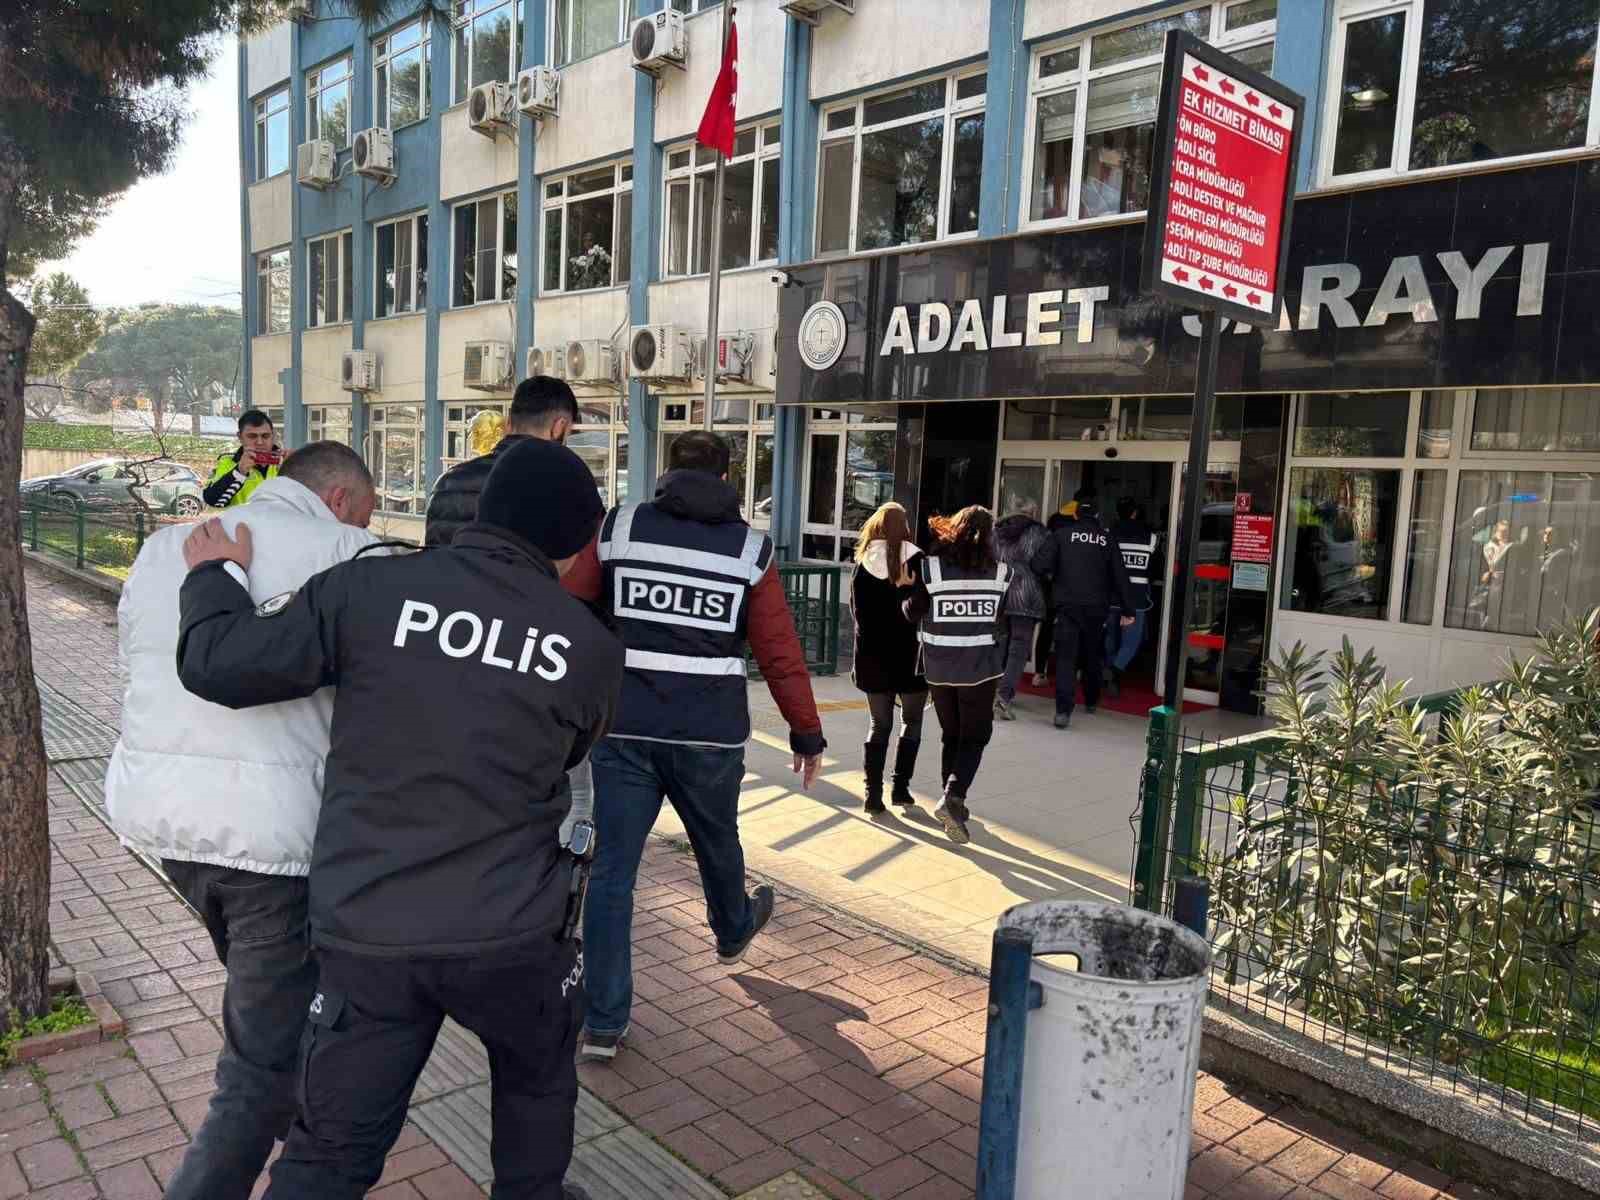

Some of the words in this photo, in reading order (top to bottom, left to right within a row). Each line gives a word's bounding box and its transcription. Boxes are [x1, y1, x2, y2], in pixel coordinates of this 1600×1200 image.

[1179, 114, 1192, 135] ÖN
[1193, 122, 1216, 145] BÜRO
[1184, 87, 1200, 111] EK
[1203, 97, 1247, 131] HİZMET
[1249, 118, 1285, 150] BİNASI
[1177, 138, 1197, 158] ADLİ
[1198, 145, 1217, 167] SİCİL
[1175, 155, 1194, 178] İCRA
[1196, 165, 1245, 198] MÜDÜRLÜĞÜ
[1171, 199, 1220, 230] HİZMETLERİ
[1220, 217, 1265, 247] MÜDÜRLÜĞÜ
[1173, 180, 1193, 199] ADLİ
[1194, 187, 1225, 210] DESTEK
[1225, 200, 1236, 215] VE
[1236, 206, 1266, 228] MAĞDUR
[1169, 221, 1194, 241] SEÇİM
[1195, 230, 1243, 258] MÜDÜRLÜĞÜ
[1167, 241, 1188, 259] ADLİ
[1188, 248, 1202, 264] TIP
[1202, 253, 1223, 271] ŞUBE
[1222, 260, 1268, 287] MÜDÜRLÜĞÜ
[880, 285, 1110, 356] ADALET
